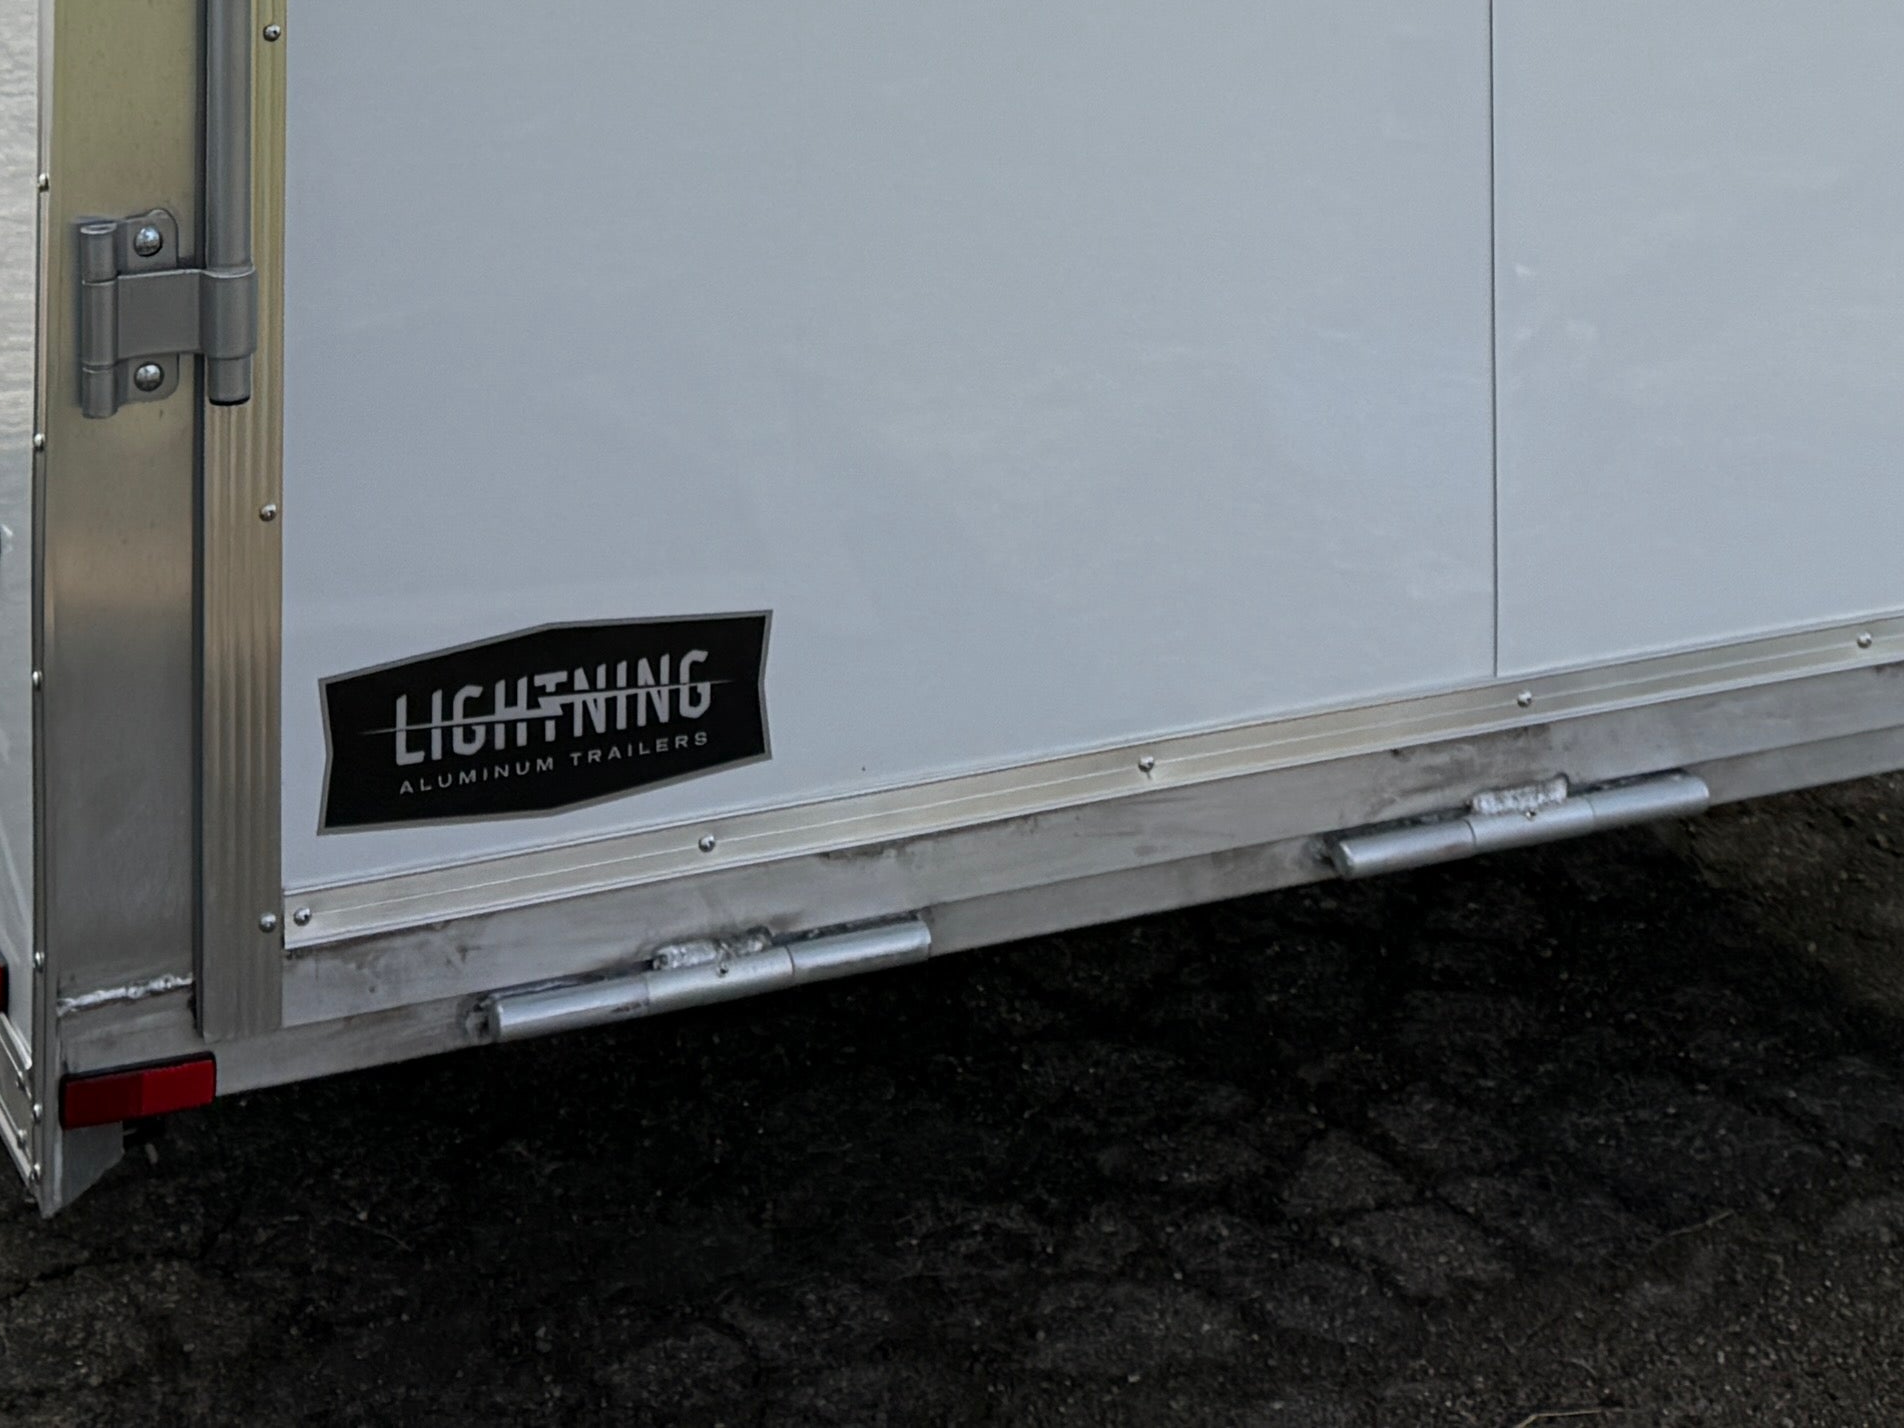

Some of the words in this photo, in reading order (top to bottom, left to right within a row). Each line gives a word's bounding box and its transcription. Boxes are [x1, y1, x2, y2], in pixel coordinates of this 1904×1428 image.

[395, 648, 712, 767] LIGHTNING
[398, 757, 555, 796] ALUMINUM
[569, 731, 709, 767] TRAILERS
